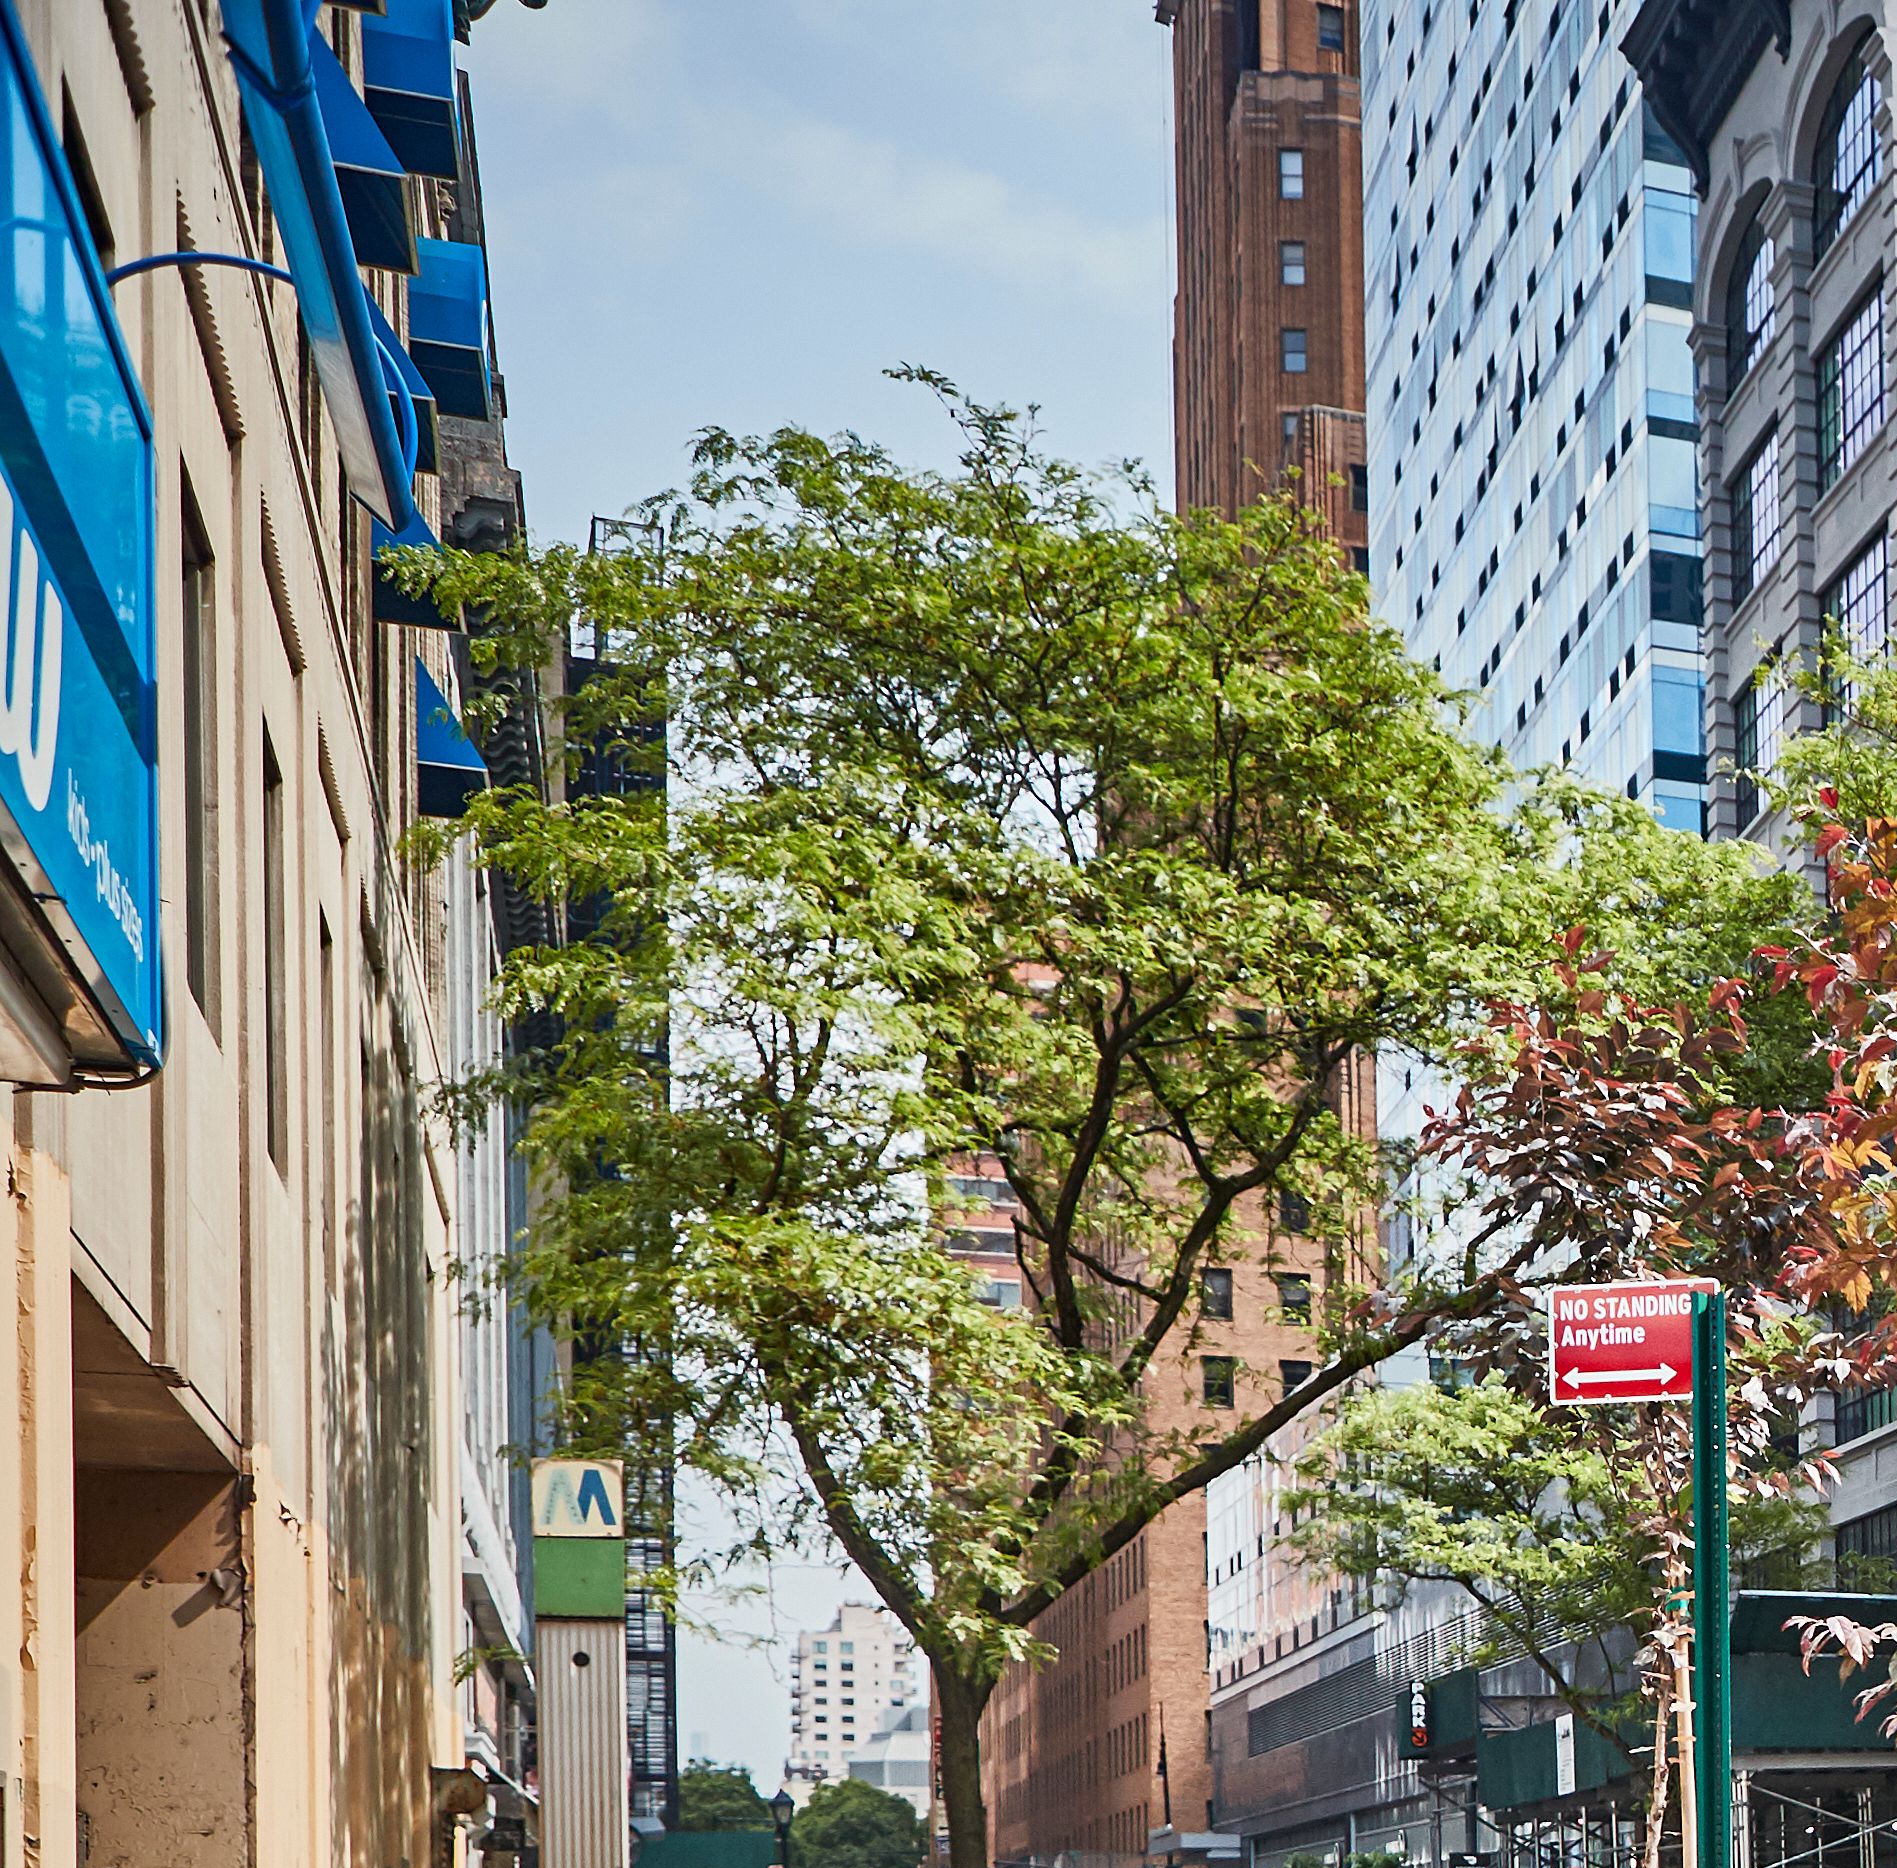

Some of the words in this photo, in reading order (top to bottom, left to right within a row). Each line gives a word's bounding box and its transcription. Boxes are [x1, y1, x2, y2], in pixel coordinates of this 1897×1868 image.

[1559, 1298, 1588, 1321] NO
[1593, 1293, 1692, 1320] STANDING
[1560, 1322, 1646, 1350] Anytime
[1411, 1682, 1427, 1728] PARK
